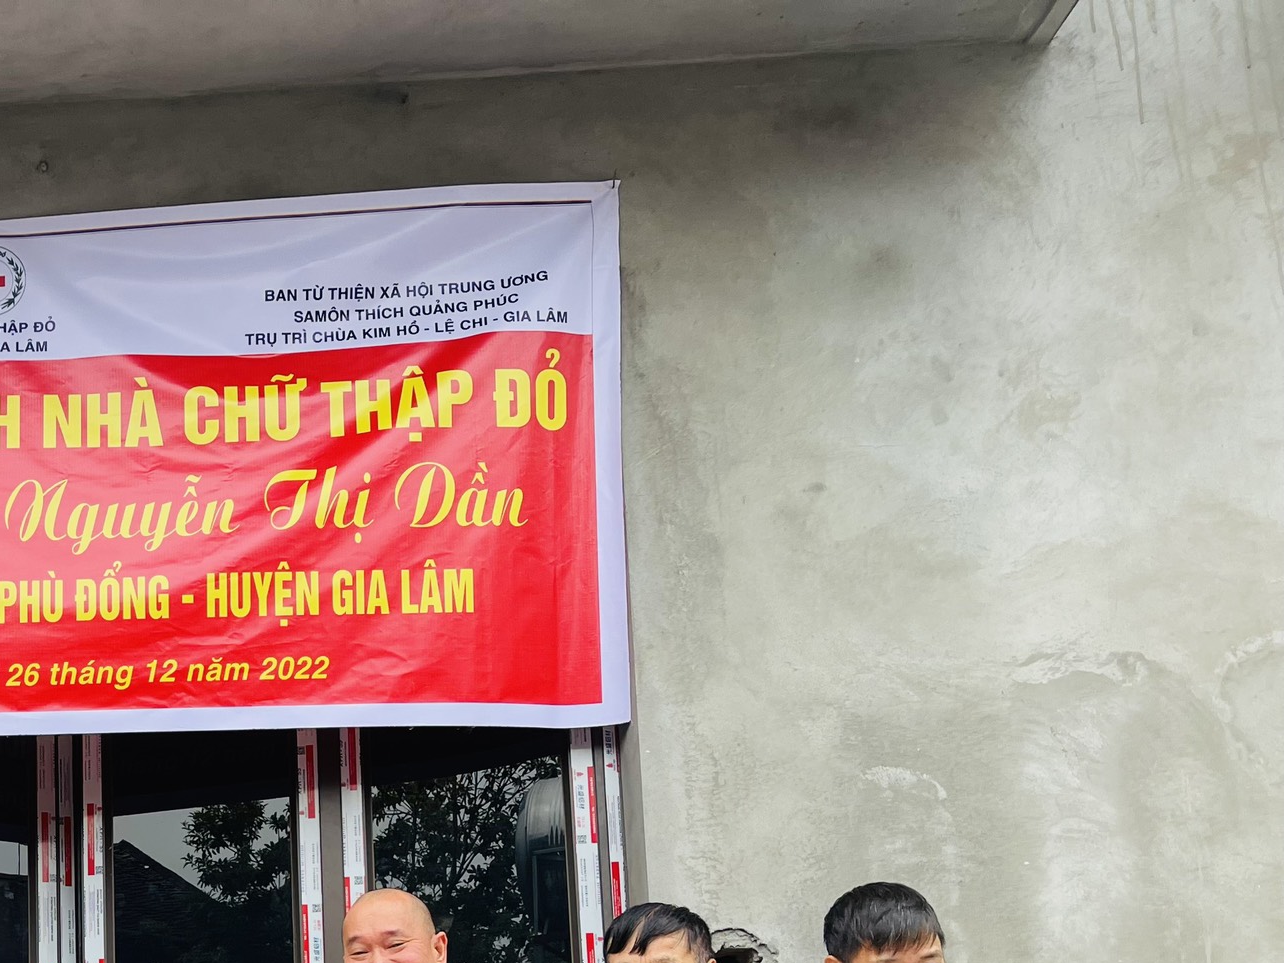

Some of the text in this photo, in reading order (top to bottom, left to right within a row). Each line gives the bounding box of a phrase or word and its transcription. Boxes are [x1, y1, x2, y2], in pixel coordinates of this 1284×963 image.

[264, 270, 549, 303] BAN TỪ THIỆN XÃ HỘI TRUNG ƯƠNG
[32, 315, 56, 333] ĐỎ
[293, 293, 520, 324] SAMÔN THÍCH QUẢNG PHÚC
[244, 332, 277, 348] TRỤ
[281, 328, 307, 345] TRÌ
[312, 327, 358, 344] CHÙA
[362, 326, 391, 340] KIM
[434, 318, 455, 335] LỆ
[459, 315, 489, 331] CHI
[503, 310, 532, 323] GIA
[536, 307, 568, 324] LÂM
[15, 338, 48, 353] LÂM
[44, 376, 164, 450] NHÀ
[185, 373, 308, 446] CHỮ
[321, 365, 474, 443] THẬP
[492, 348, 568, 432] ĐỎ
[4, 474, 237, 556] Nguyễn
[264, 466, 374, 545] Thị
[396, 461, 526, 529] Dần
[75, 561, 171, 622] ĐỔNG
[183, 595, 195, 605] -
[207, 561, 320, 628] HUYỆN
[332, 570, 391, 617] GIA
[401, 559, 475, 615] LÂM
[7, 664, 41, 687] 26
[51, 663, 134, 691] tháng
[145, 661, 179, 684] 12
[187, 656, 250, 683] năm
[261, 657, 331, 681] 2022
